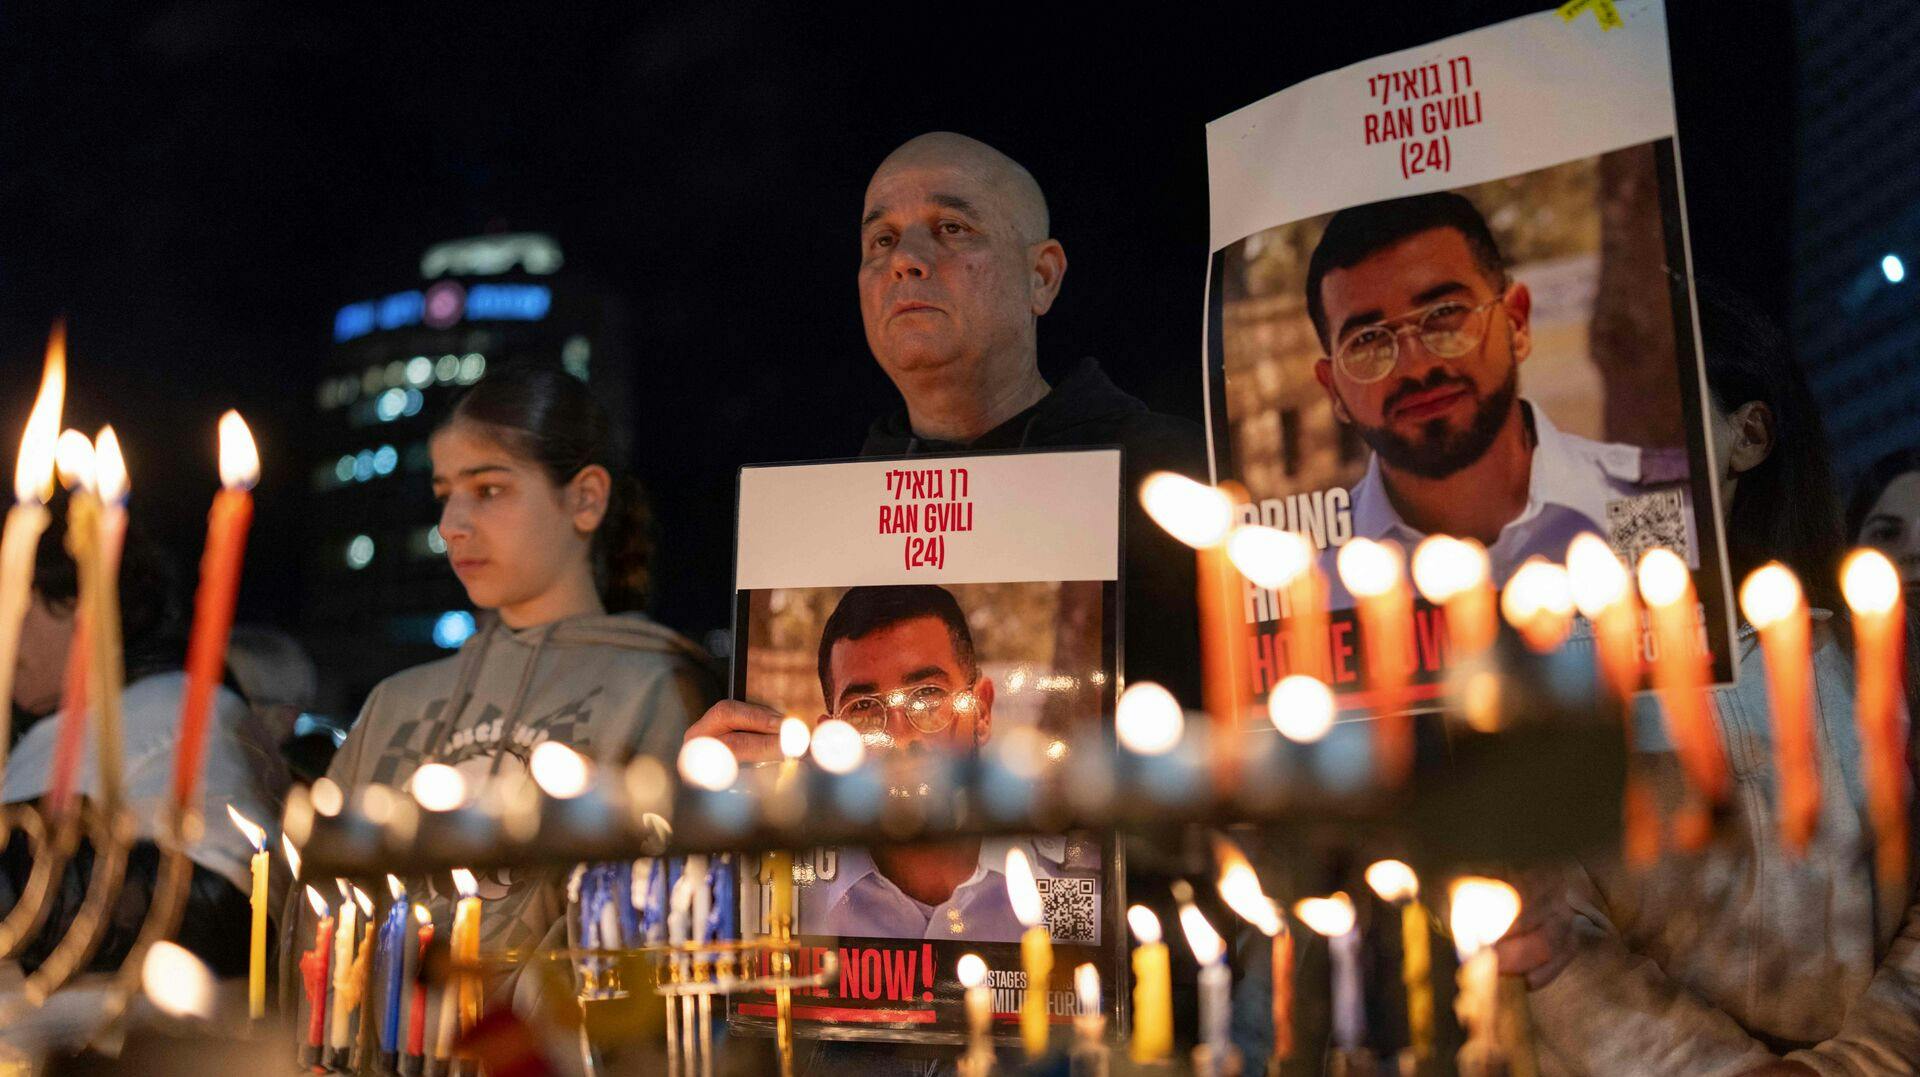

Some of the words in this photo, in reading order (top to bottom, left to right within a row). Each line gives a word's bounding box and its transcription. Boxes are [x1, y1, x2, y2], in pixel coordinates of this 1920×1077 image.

[1368, 64, 1442, 105] גואילי
[1448, 56, 1472, 94] רן
[1364, 107, 1413, 146] RAN
[1421, 91, 1483, 136] GVILI
[1400, 136, 1452, 180] (24)
[885, 469, 943, 500] גואילי
[950, 468, 969, 502] רן
[879, 504, 918, 535] RAN
[924, 502, 973, 534] GVILI
[905, 535, 944, 570] (24)
[839, 944, 934, 1003] NOW!
[981, 970, 1027, 989] STAGES
